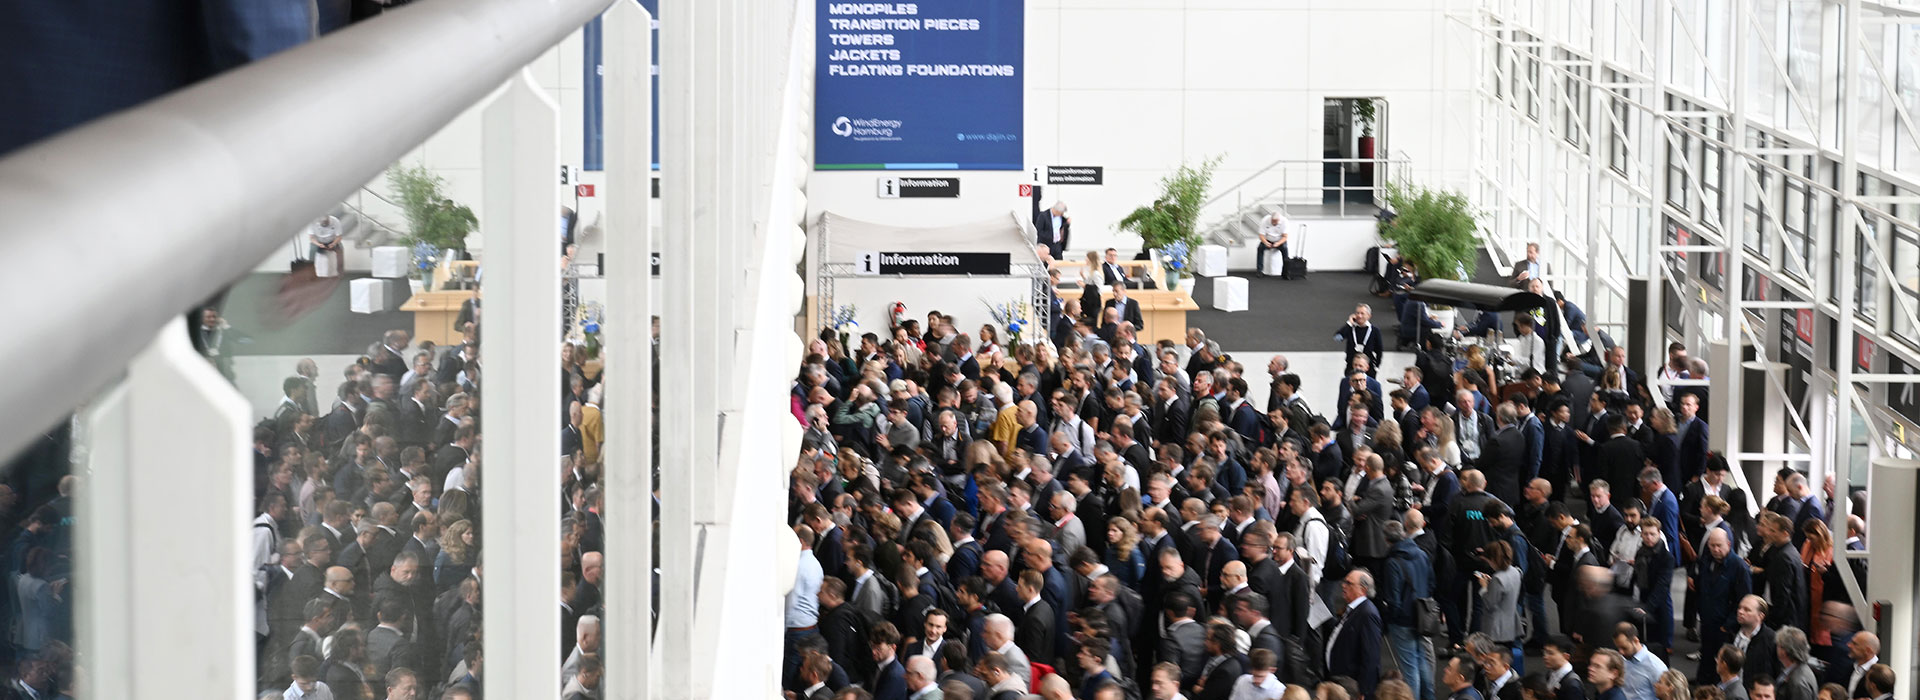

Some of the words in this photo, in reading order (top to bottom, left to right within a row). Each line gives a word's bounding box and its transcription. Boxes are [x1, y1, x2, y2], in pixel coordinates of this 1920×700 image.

[829, 3, 918, 15] MONOPILES
[829, 19, 920, 31] TRANSITION
[924, 19, 980, 31] PIECES
[829, 34, 894, 46] TOWERS
[829, 50, 900, 61] JACKETS
[829, 64, 903, 77] FLOATING
[906, 64, 1014, 77] FOUNDATIONS
[853, 118, 902, 129] WindEnergy
[853, 128, 893, 137] Hamburg
[899, 178, 949, 188] Information
[880, 253, 960, 266] Information
